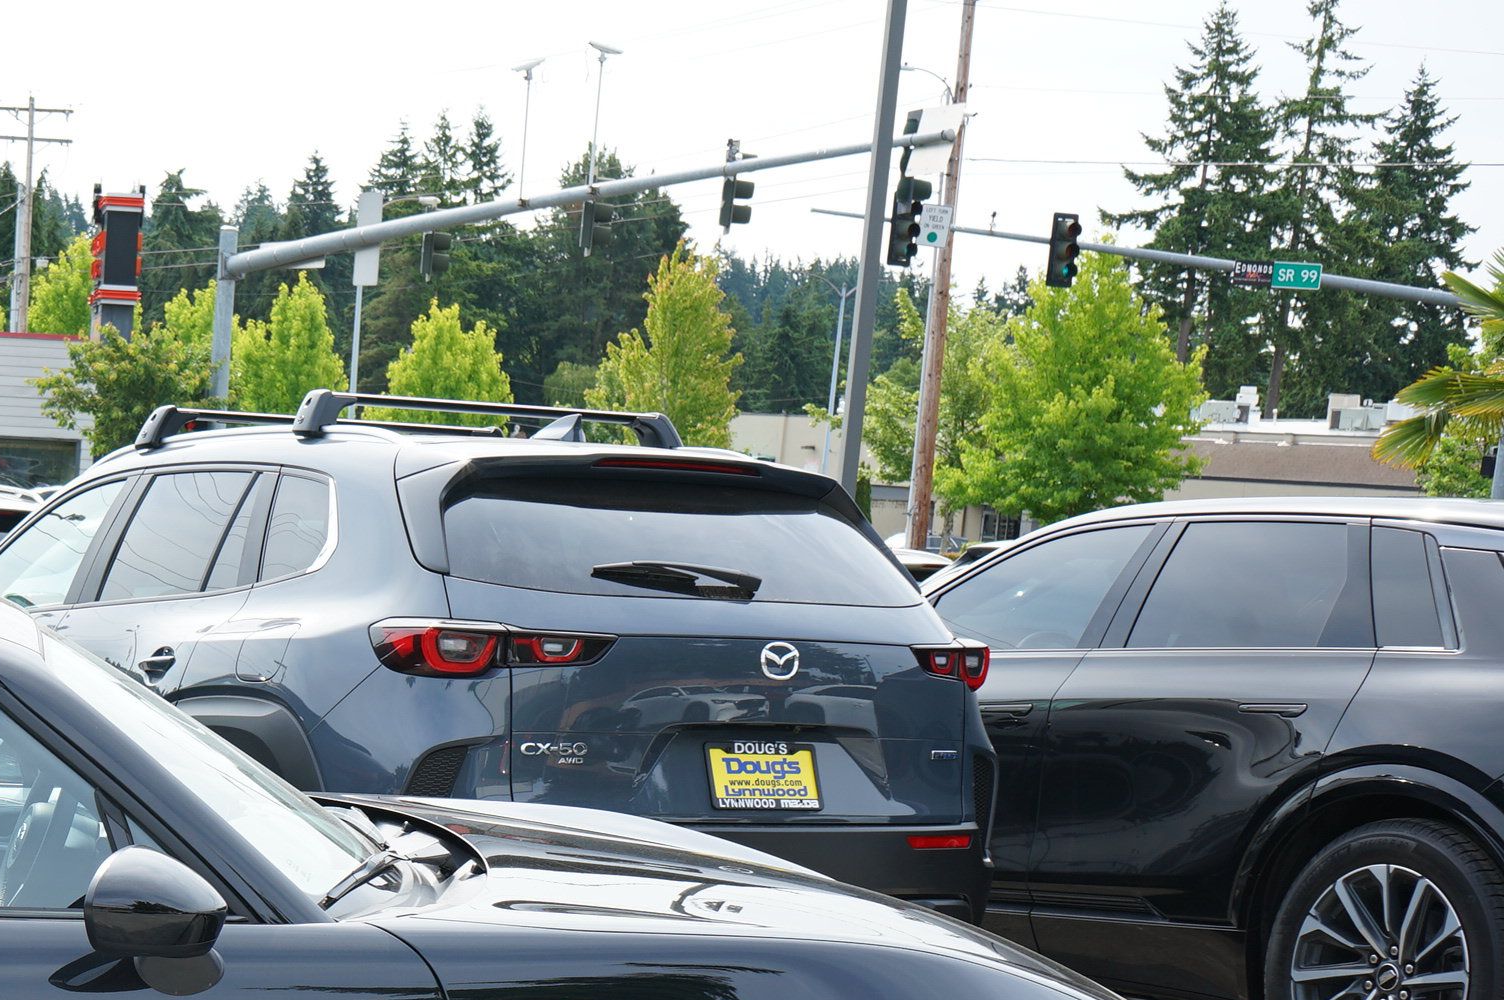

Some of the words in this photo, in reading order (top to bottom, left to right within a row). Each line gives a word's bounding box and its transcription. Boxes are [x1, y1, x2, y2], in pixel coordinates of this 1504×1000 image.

[1235, 261, 1273, 275] EDMONDS
[1277, 268, 1295, 283] SR
[1300, 269, 1318, 284] 99
[520, 742, 588, 756] CX-50
[734, 742, 788, 755] DOUG'S
[558, 757, 584, 765] AWD
[722, 757, 801, 780] Doug's
[729, 778, 803, 788] www.dougs.com
[724, 785, 808, 797] Lynnwood
[718, 798, 776, 808] LYNNWOOD
